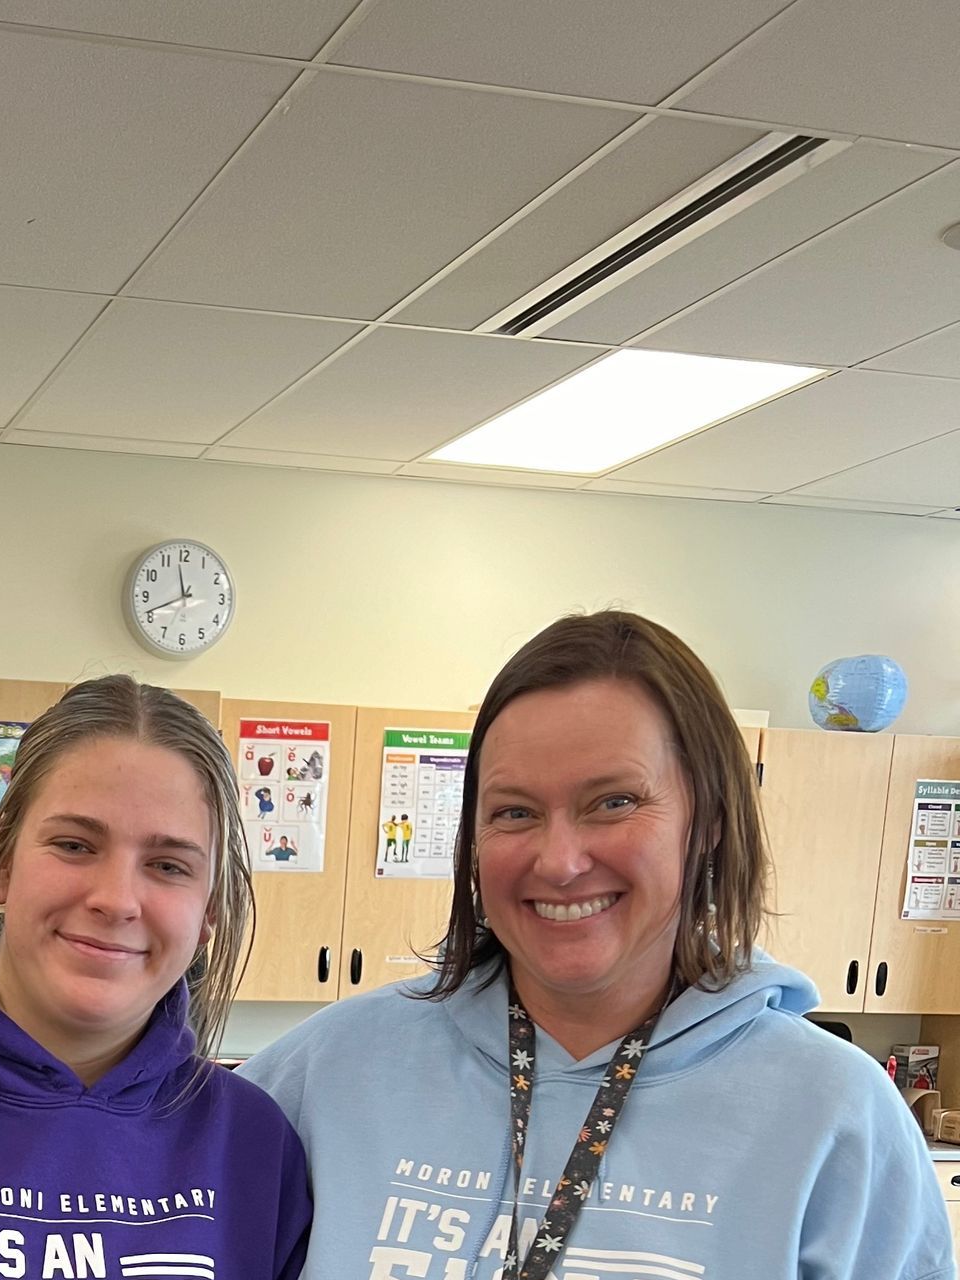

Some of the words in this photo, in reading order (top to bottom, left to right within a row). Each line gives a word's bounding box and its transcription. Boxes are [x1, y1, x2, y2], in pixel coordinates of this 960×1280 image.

[161, 554, 170, 567] 11
[179, 549, 191, 563] 12
[146, 569, 158, 582] 10
[213, 572, 221, 585] 2
[142, 591, 150, 603] 9
[218, 593, 226, 606] 3
[146, 611, 154, 624] 8
[212, 613, 220, 626] 4
[160, 626, 168, 639] 7
[197, 628, 205, 640] 5
[178, 633, 186, 646] 6
[256, 724, 281, 735] Short
[282, 726, 313, 737] Vowels
[402, 733, 427, 744] Vowel
[428, 734, 454, 745] Teams
[918, 785, 950, 796] Syllable
[395, 1158, 491, 1190] MORON
[522, 1177, 719, 1215] ELENTARY
[60, 1188, 216, 1217] ELEMENTARY
[377, 1196, 471, 1252] IT'S
[42, 1232, 107, 1279] AN
